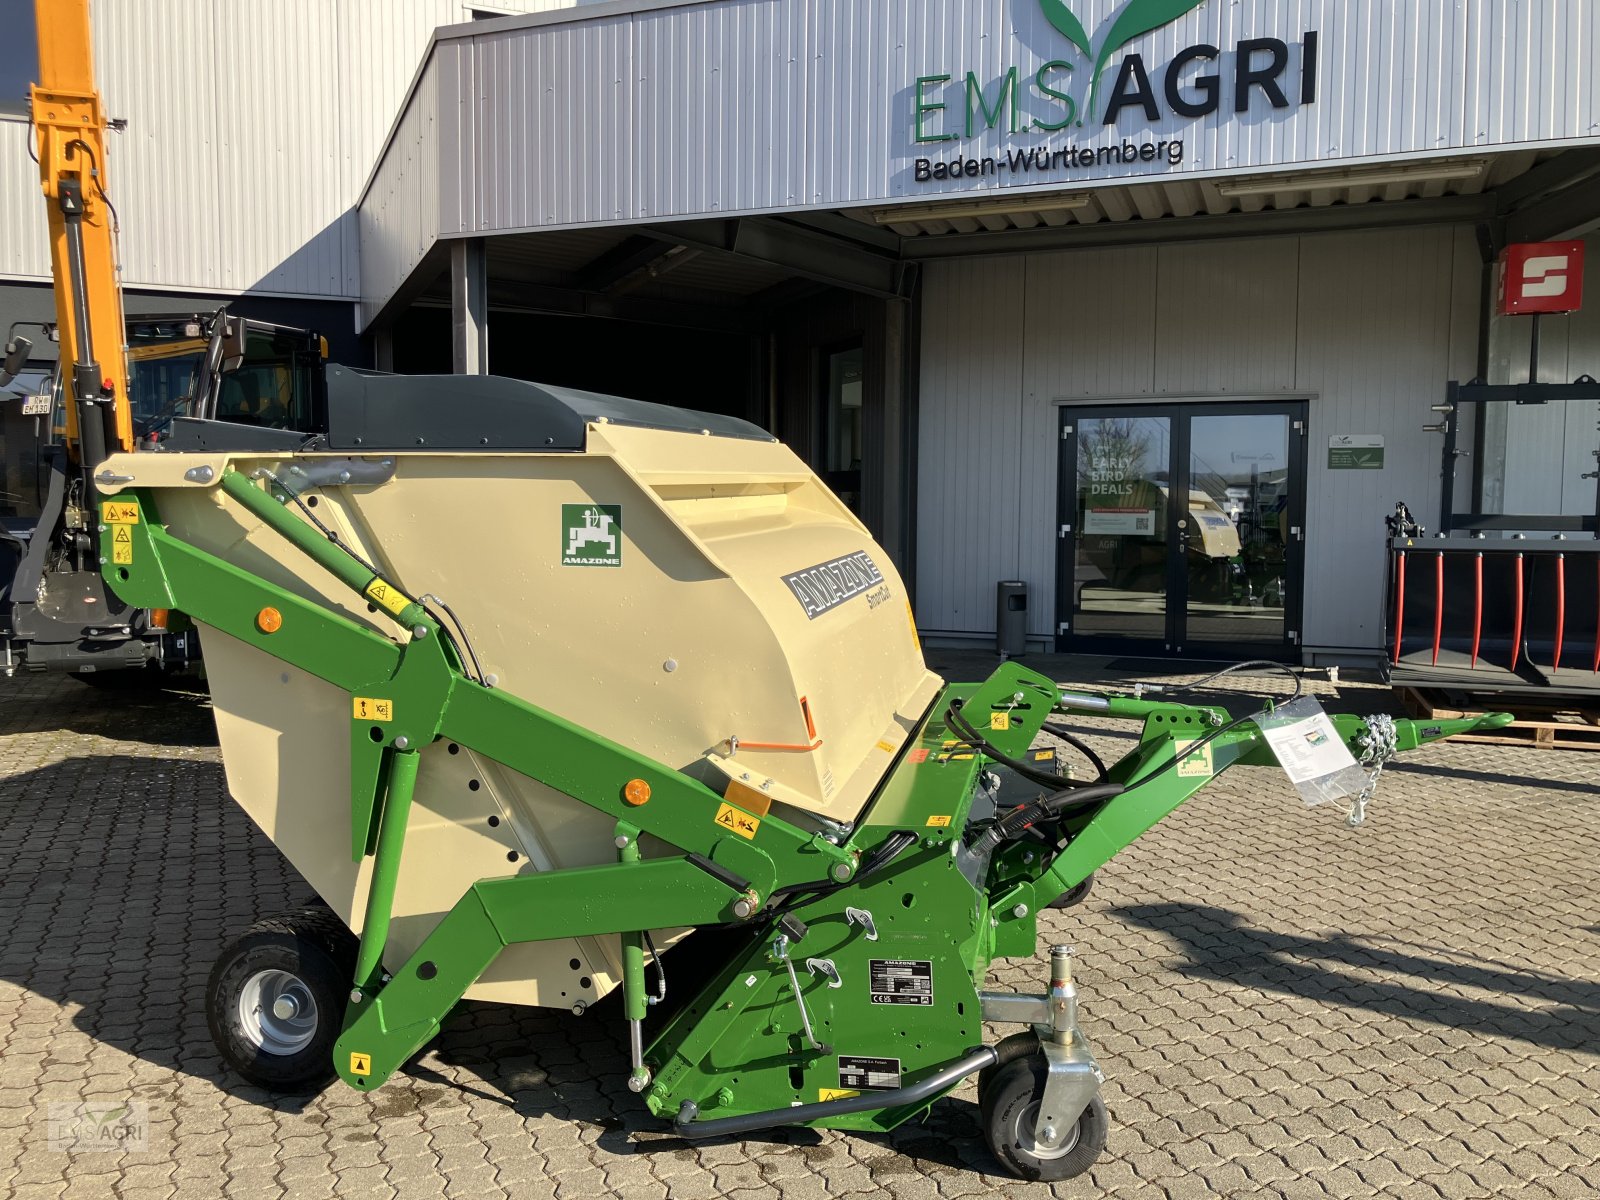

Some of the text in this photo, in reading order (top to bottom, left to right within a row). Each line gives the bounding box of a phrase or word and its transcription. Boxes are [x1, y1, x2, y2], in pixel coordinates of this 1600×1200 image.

[1103, 30, 1318, 126] AGRI
[914, 138, 1184, 182] Baden-Württemberg
[1092, 457, 1133, 468] EARLY
[1091, 470, 1124, 481] BIRD
[1091, 484, 1133, 495] DEALS
[563, 557, 620, 565] AMAZONE
[789, 552, 883, 616] AMAZONE
